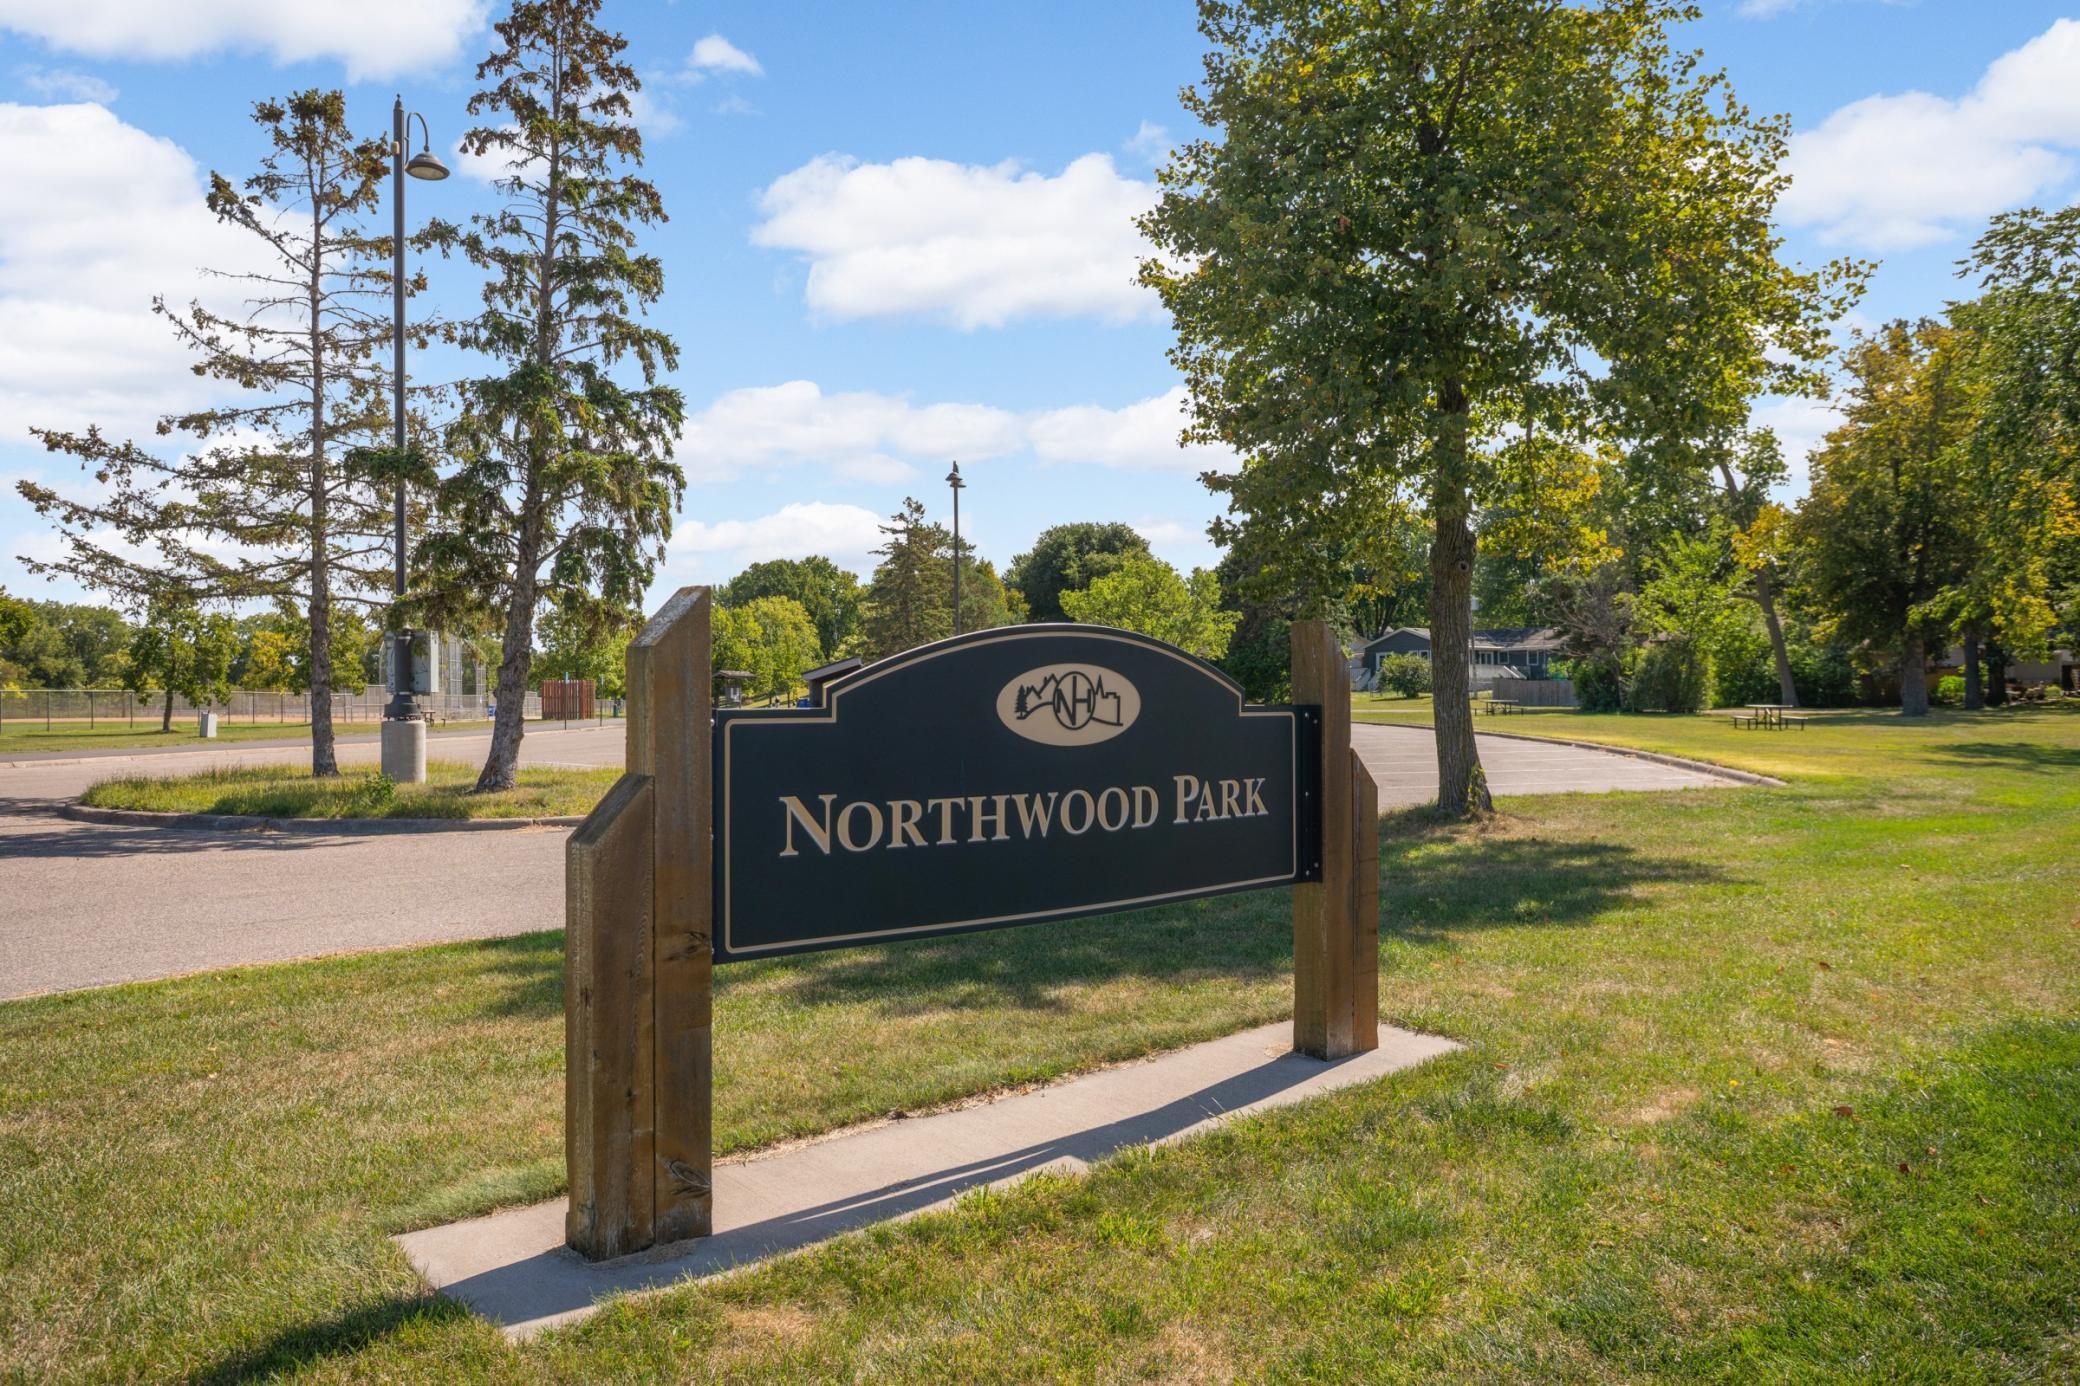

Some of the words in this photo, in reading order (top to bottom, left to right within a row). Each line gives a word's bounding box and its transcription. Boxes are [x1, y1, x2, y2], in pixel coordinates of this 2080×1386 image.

[1055, 675, 1092, 726] NH
[779, 786, 1159, 857] NORTHWOOD
[1173, 774, 1269, 824] PARK
